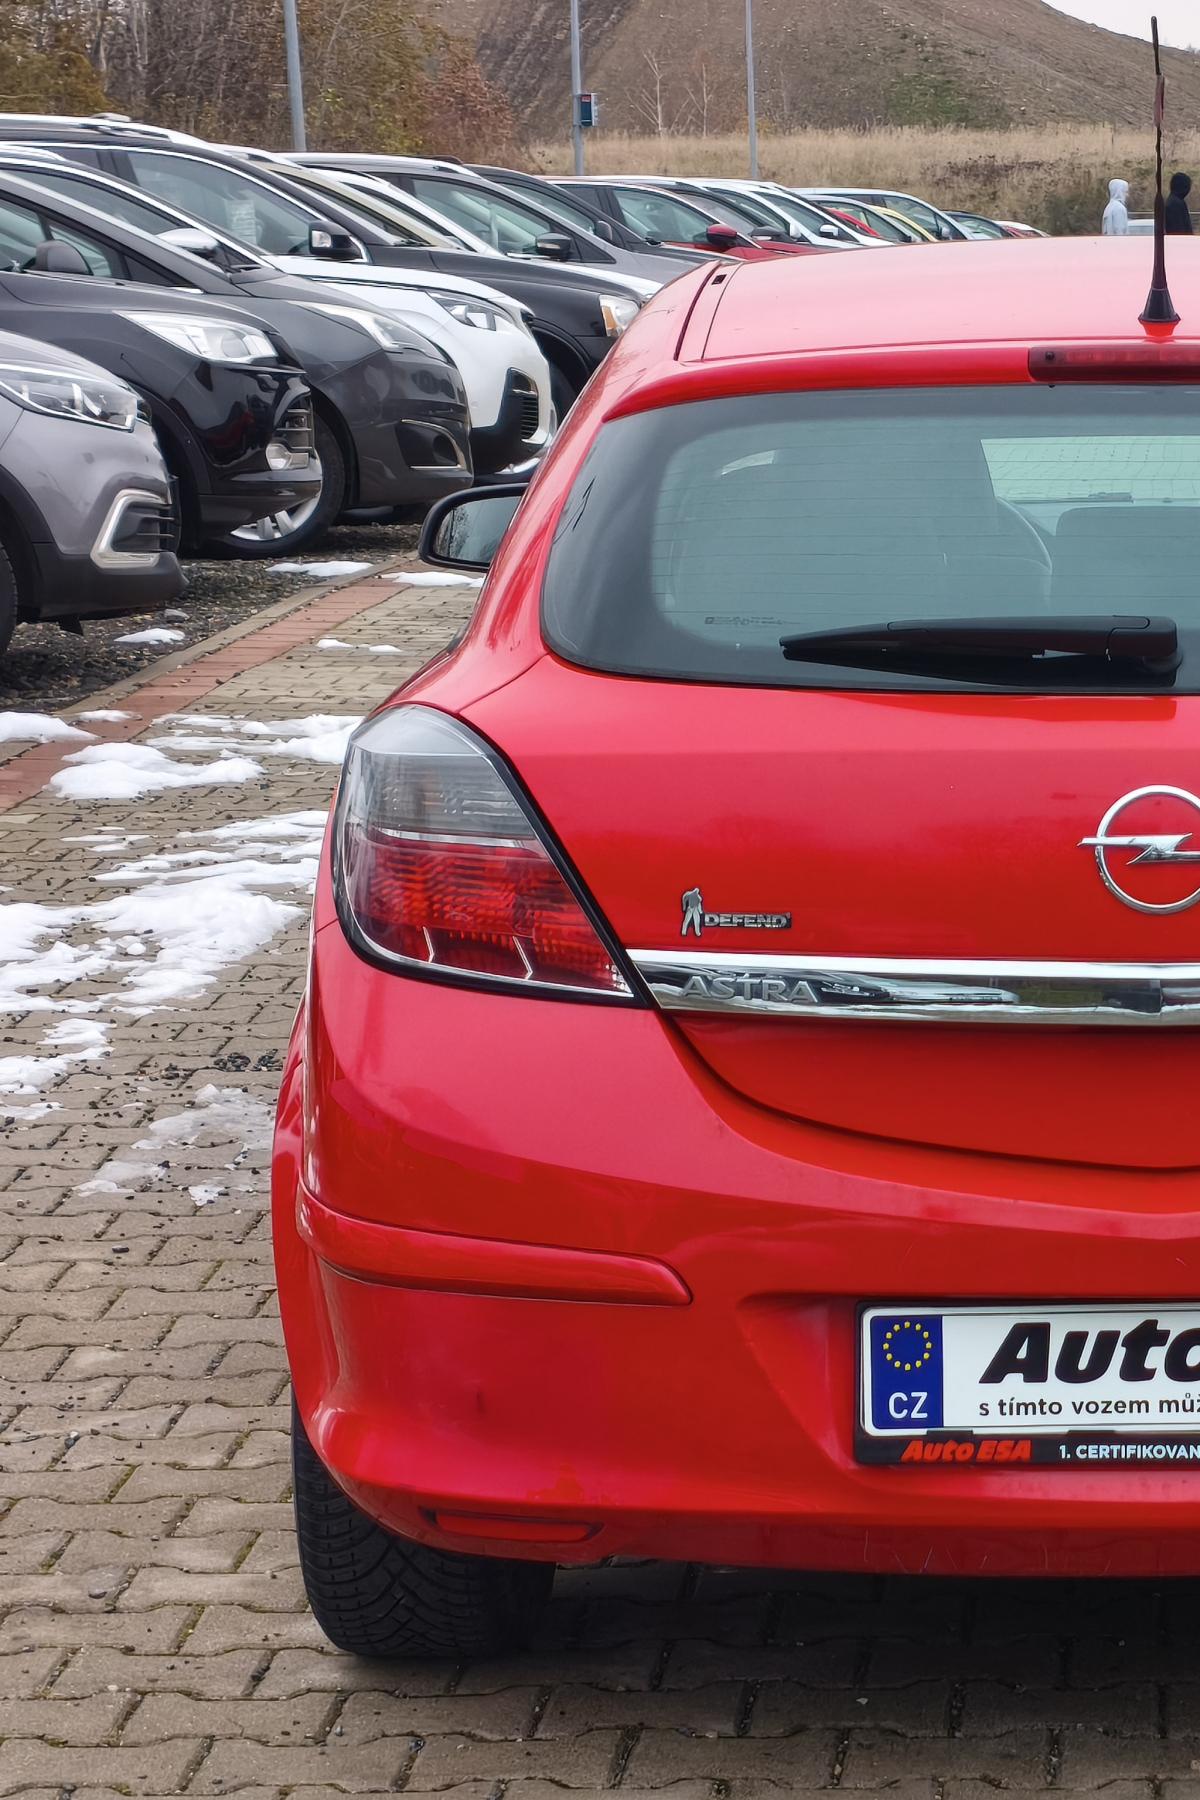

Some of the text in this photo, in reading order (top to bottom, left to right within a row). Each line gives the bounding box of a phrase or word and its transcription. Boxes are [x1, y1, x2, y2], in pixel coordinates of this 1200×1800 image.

[704, 913, 788, 928] DEFEND
[682, 975, 818, 1003] ASTRA
[888, 1391, 929, 1421] CZ
[979, 1402, 990, 1416] s
[998, 1397, 1063, 1416] tímto
[1072, 1399, 1149, 1414] vozem
[901, 1440, 1032, 1462] Auto ESA
[1059, 1444, 1071, 1459] 1.
